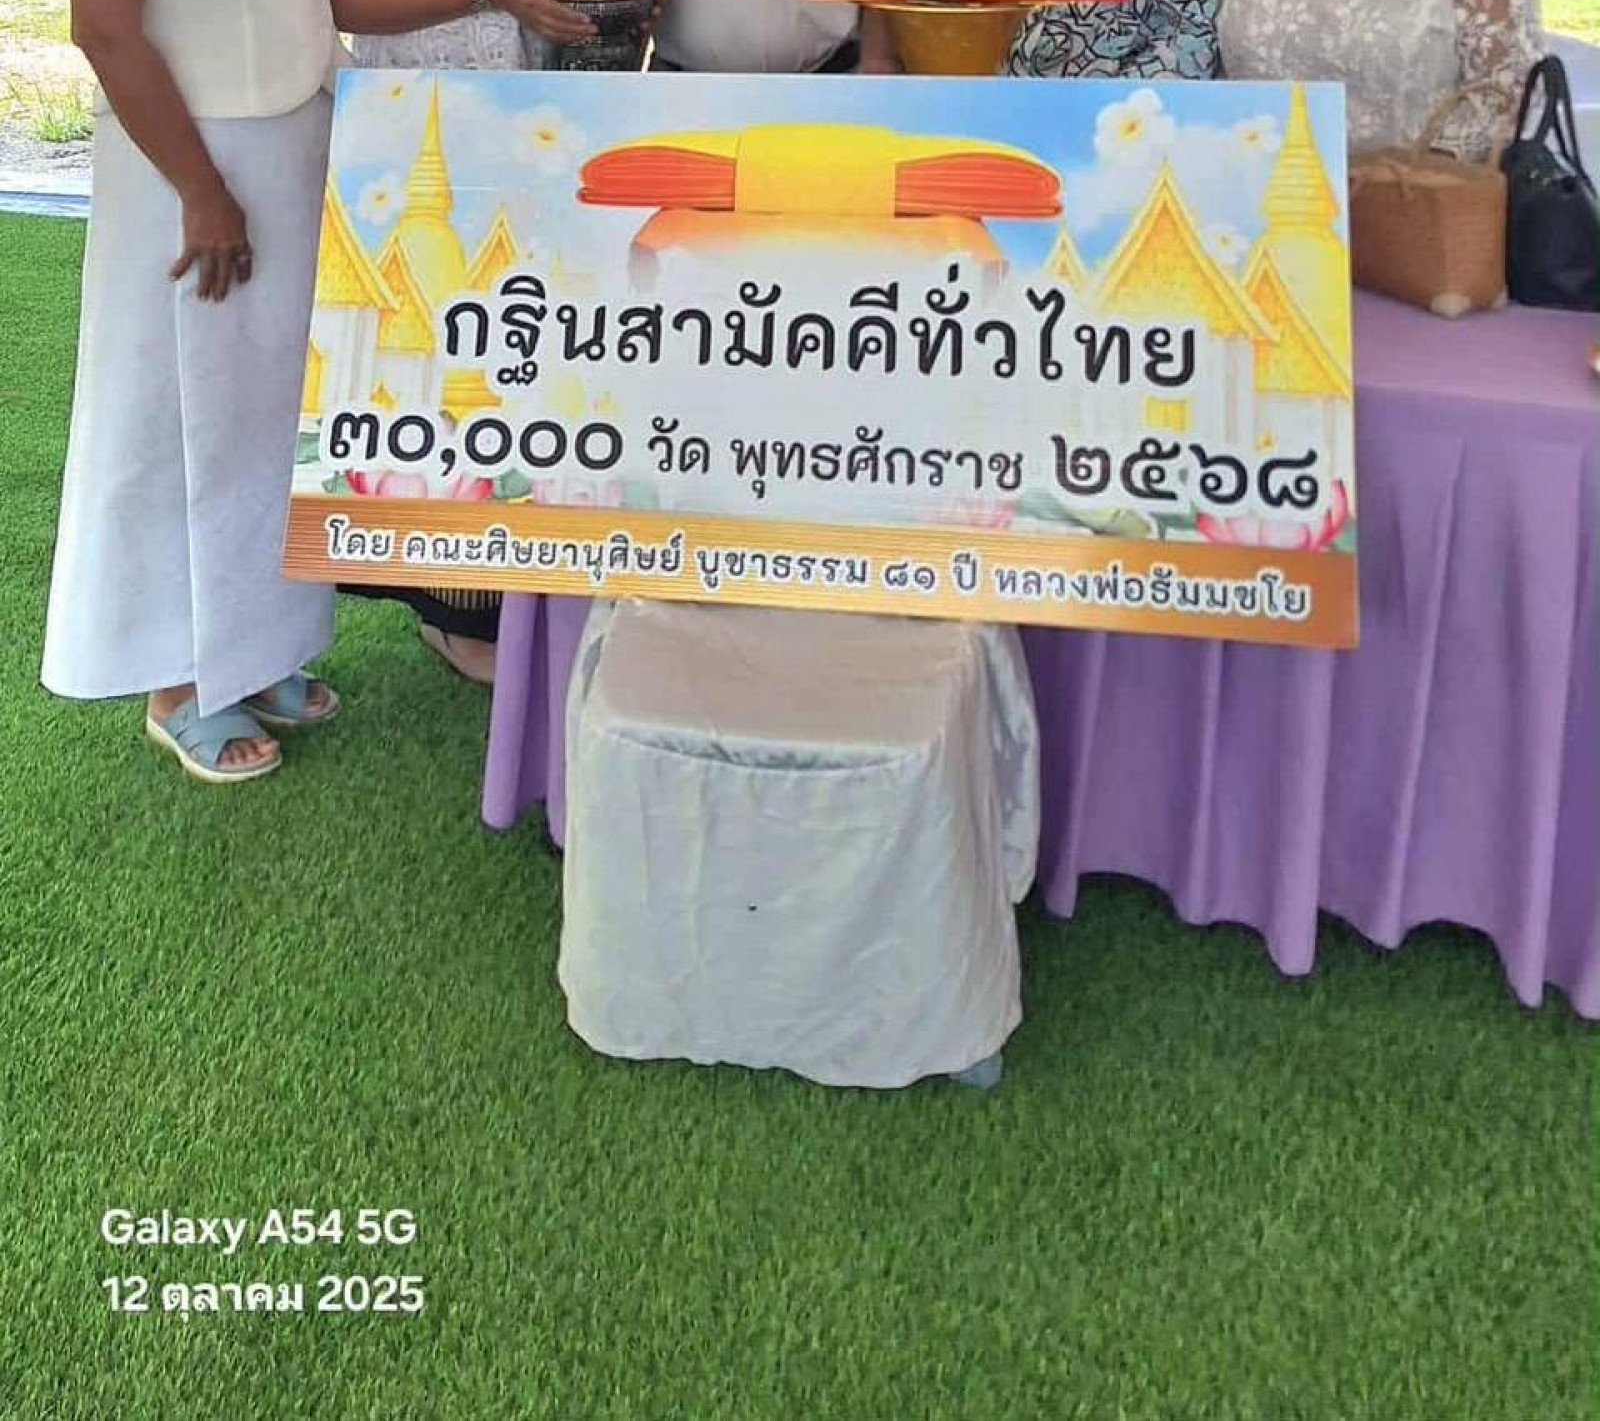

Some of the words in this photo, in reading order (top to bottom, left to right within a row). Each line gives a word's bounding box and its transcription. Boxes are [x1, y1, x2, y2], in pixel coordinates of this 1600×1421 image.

[444, 263, 1197, 387] กฐินสามัคคีทั่วไทย
[328, 411, 624, 476] ๓๐,๐๐๐
[647, 417, 711, 475] วัด
[730, 426, 1023, 499] พุทธศักราช
[1052, 434, 1320, 510] ๒๕๖๘
[329, 518, 391, 557] โดย
[406, 528, 683, 582] คณะศิษยานุศิษย์
[697, 549, 868, 589] บูชาธรรม
[884, 561, 936, 590] ๘๑
[953, 551, 977, 591] ปี
